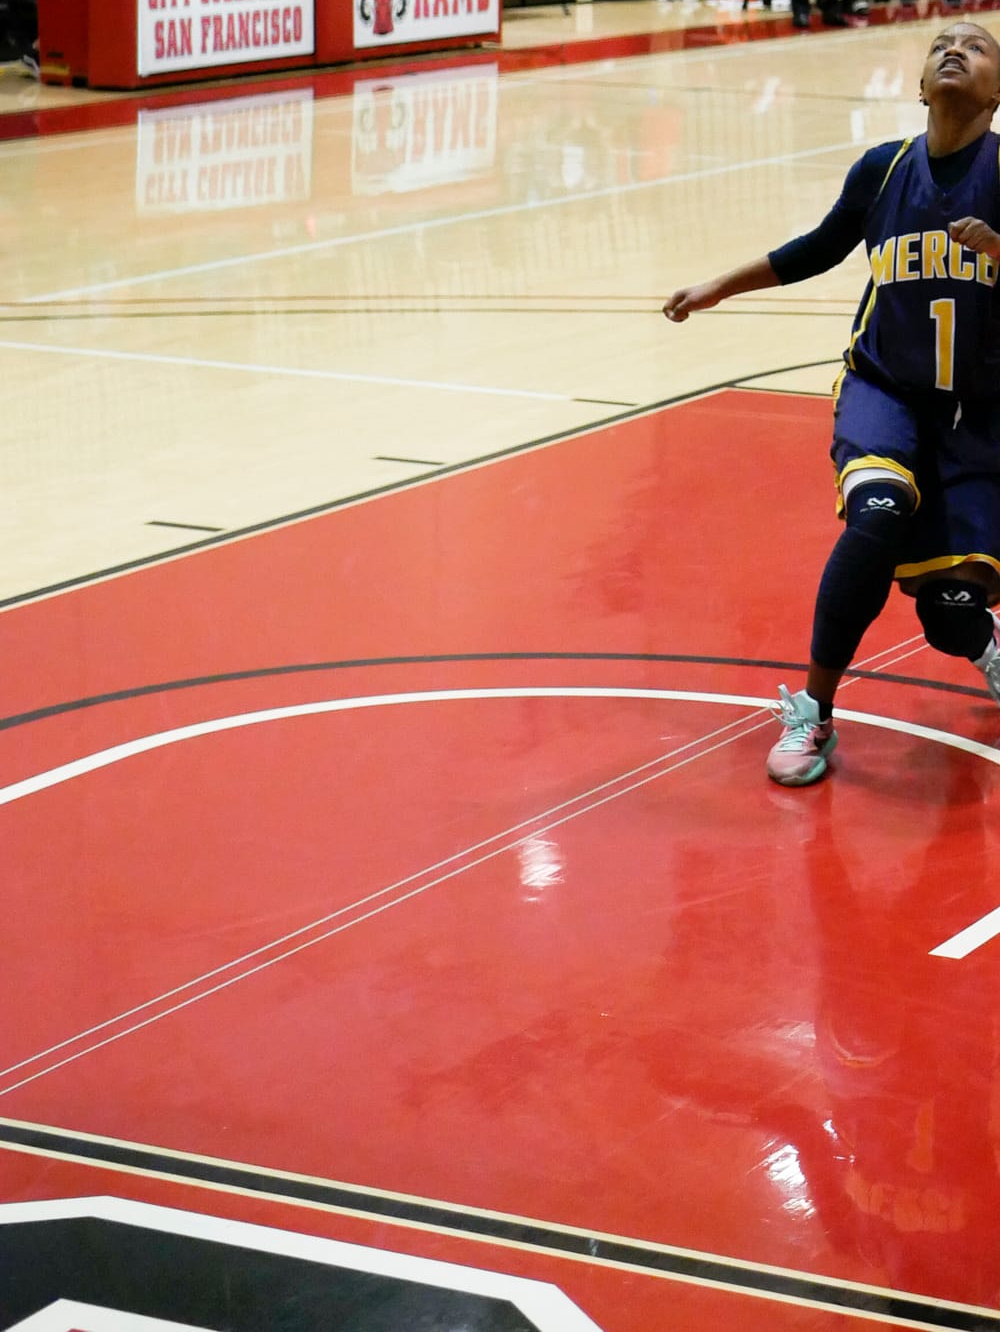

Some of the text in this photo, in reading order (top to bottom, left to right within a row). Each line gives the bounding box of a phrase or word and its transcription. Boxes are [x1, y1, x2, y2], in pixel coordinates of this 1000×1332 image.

[154, 5, 304, 60] SAN FRANCISCO
[870, 229, 1000, 288] MERCE
[929, 297, 956, 391] 1
